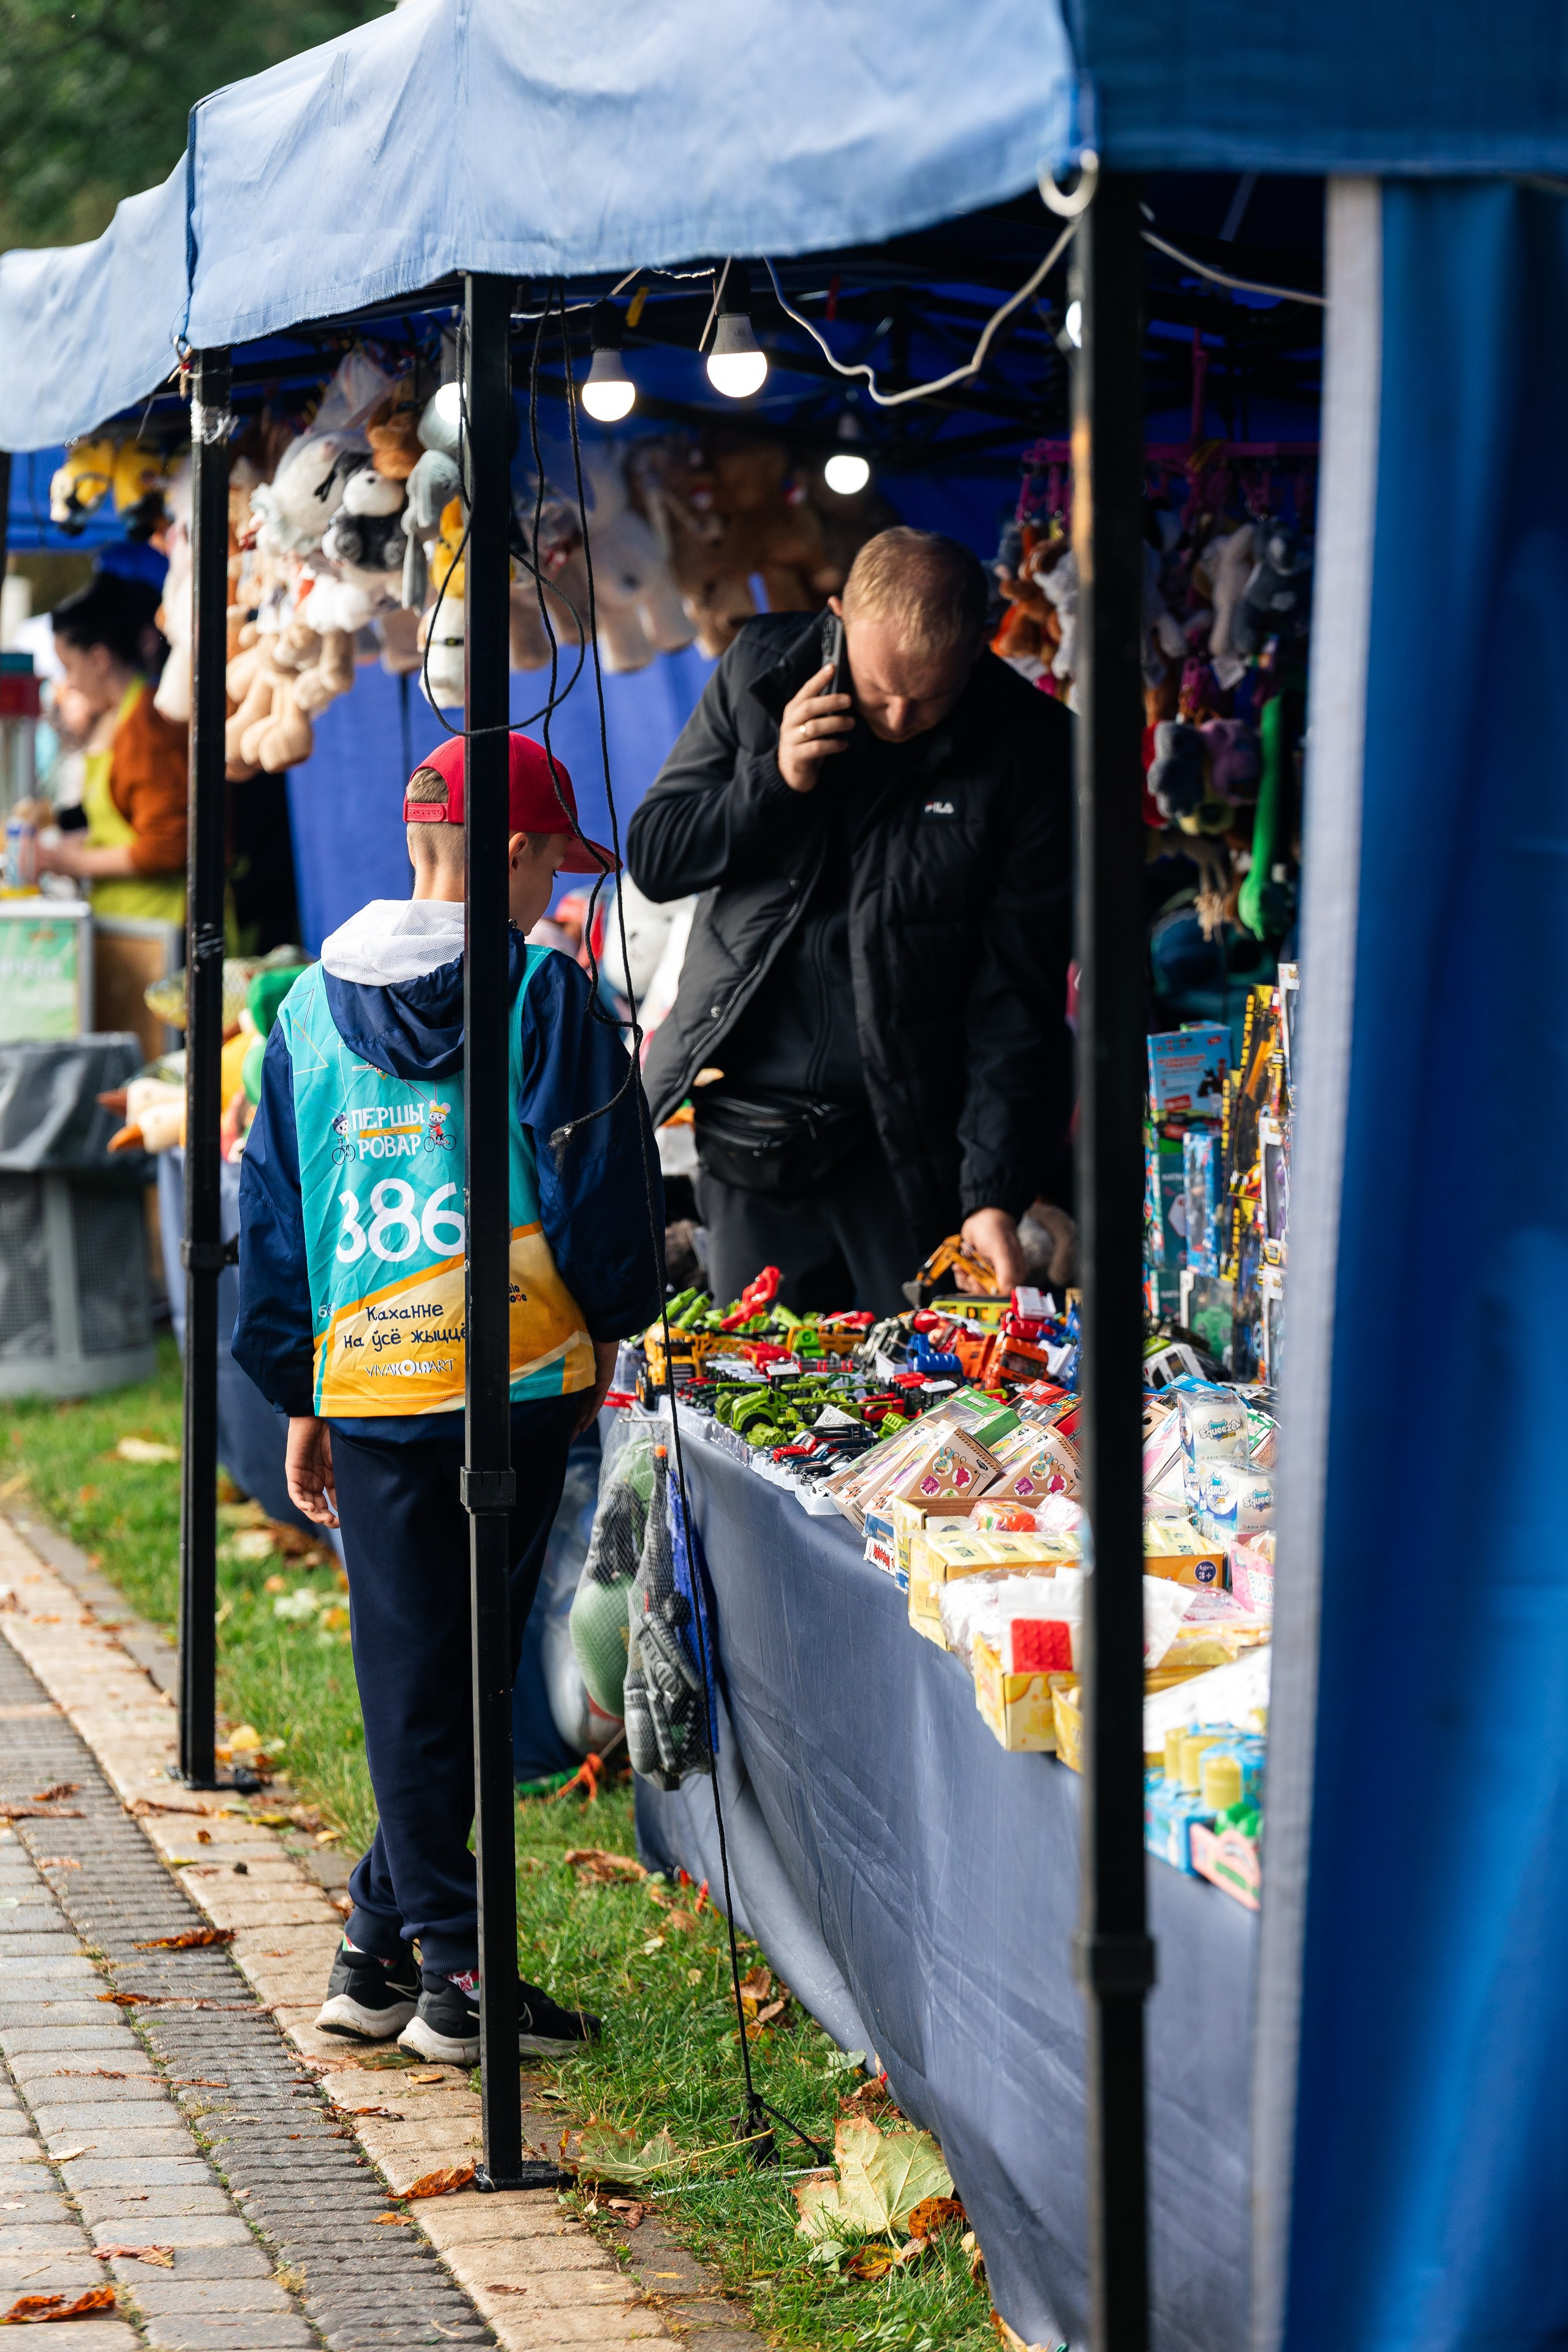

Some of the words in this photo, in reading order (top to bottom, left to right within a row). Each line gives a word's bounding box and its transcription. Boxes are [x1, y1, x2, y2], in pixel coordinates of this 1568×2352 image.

[924, 801, 955, 814] FILA
[350, 1102, 425, 1131] ПЕРШЫ
[356, 1134, 421, 1160] РОВАР
[336, 1178, 465, 1264] 386
[366, 1303, 444, 1322] Каханне
[371, 1328, 402, 1352] ўсё
[1243, 1495, 1275, 1509] Squeez
[1199, 1570, 1212, 1580] 3+
